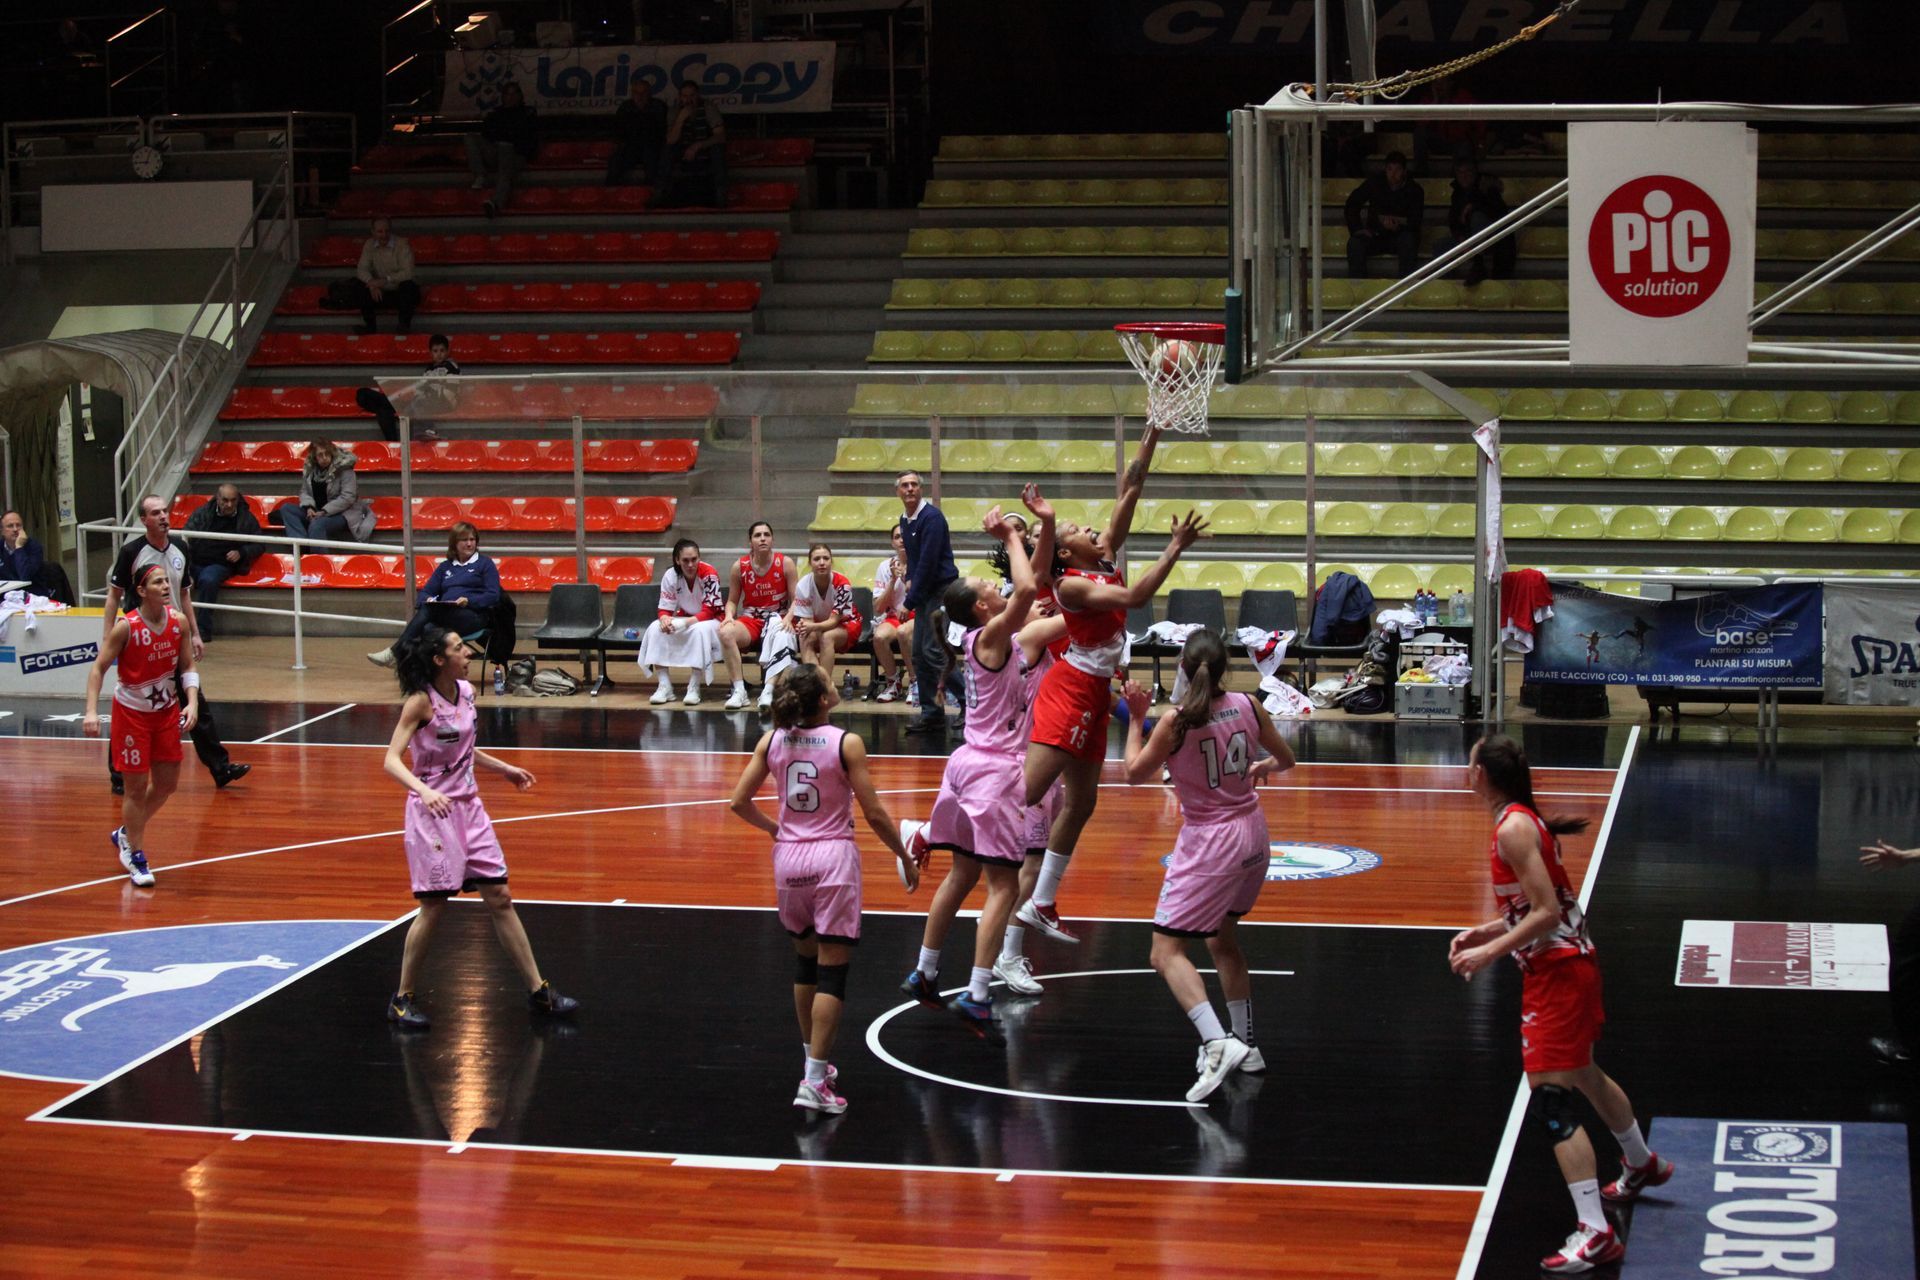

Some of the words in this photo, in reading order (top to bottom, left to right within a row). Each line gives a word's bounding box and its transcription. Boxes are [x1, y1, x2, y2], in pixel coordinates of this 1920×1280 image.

[1143, 0, 1850, 45] CHARELLA
[1623, 278, 1699, 297] solution
[741, 570, 756, 585] 13
[132, 628, 151, 647] 18
[153, 639, 172, 651] Città
[147, 654, 155, 662] di
[1710, 646, 1741, 655] martino
[1743, 645, 1774, 655] ronzoni
[1850, 634, 1920, 679] SPA
[1695, 658, 1740, 668] PLANTARI
[1742, 658, 1755, 668] SU
[1756, 658, 1793, 668] MISURA
[1530, 670, 1559, 680] LURATE
[1561, 671, 1606, 681] CACCIVIO
[1607, 671, 1629, 683] (CO)
[1636, 673, 1650, 682] Tel.
[1682, 674, 1701, 683] 950
[1709, 674, 1816, 685] www.martinoronzoni.com
[1892, 679, 1917, 688] TRUE
[1070, 724, 1088, 750] 15
[121, 748, 141, 766] 18
[1199, 729, 1249, 790] 14
[785, 760, 821, 814] 6
[1699, 1167, 1838, 1280] TOR
